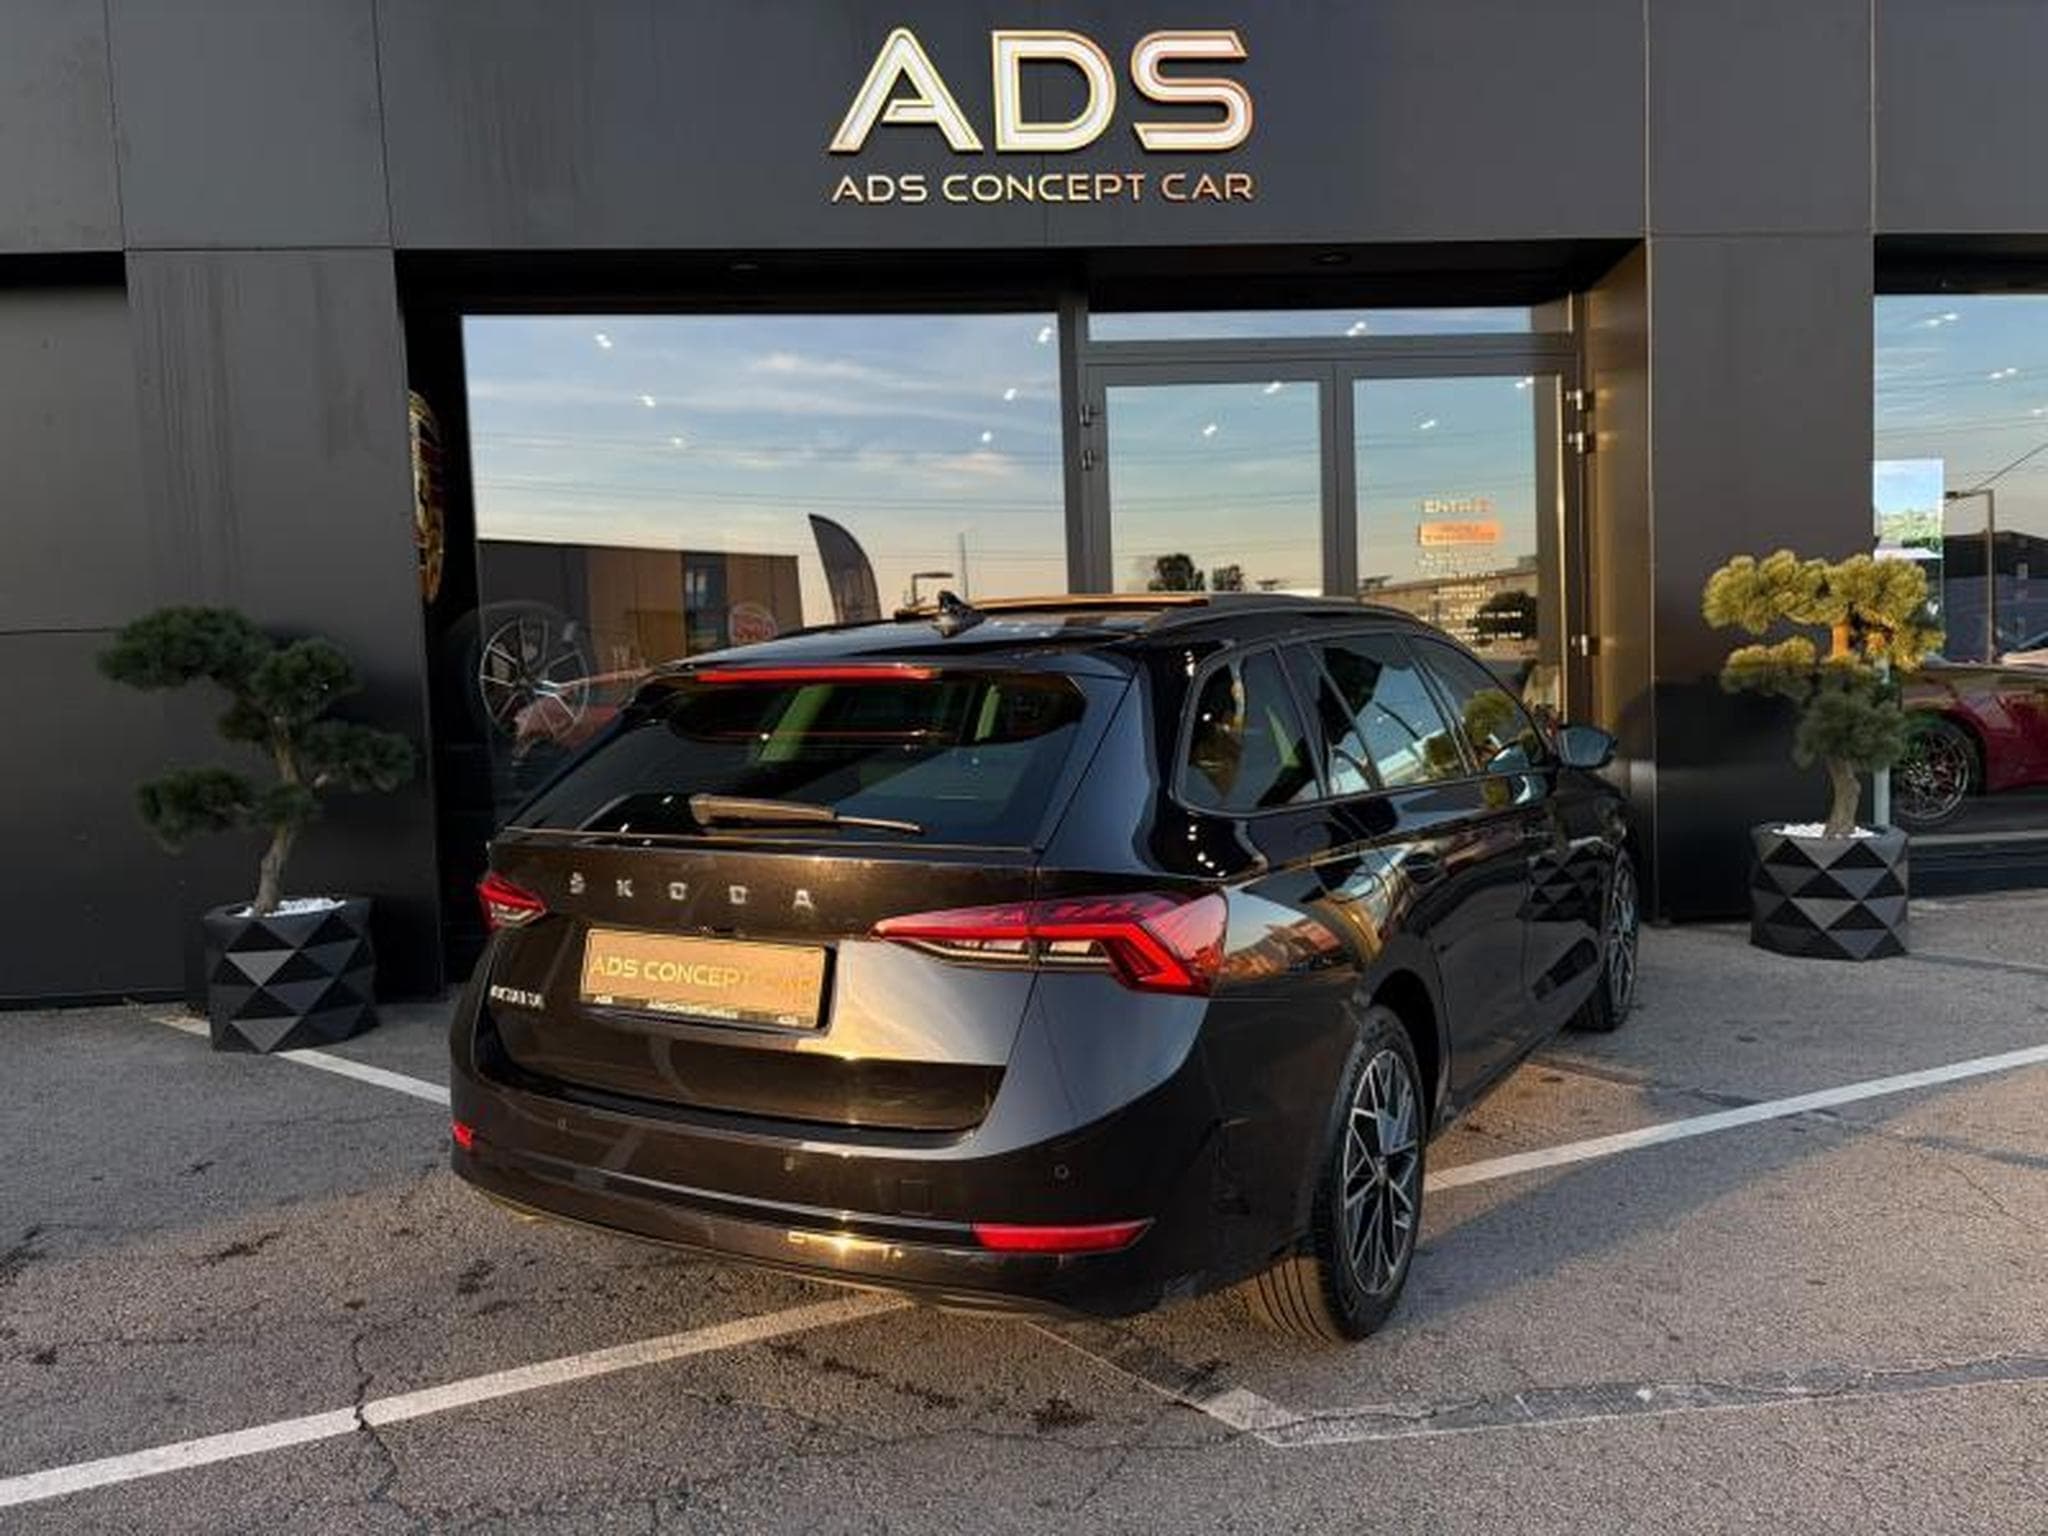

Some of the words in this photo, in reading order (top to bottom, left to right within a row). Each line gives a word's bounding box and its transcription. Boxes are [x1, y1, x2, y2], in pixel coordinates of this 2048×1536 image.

[829, 27, 1254, 152] ADS
[831, 175, 928, 203] ADS
[942, 175, 1146, 203] CONCEPT
[1161, 173, 1254, 201] CAR
[590, 954, 639, 979] ADS
